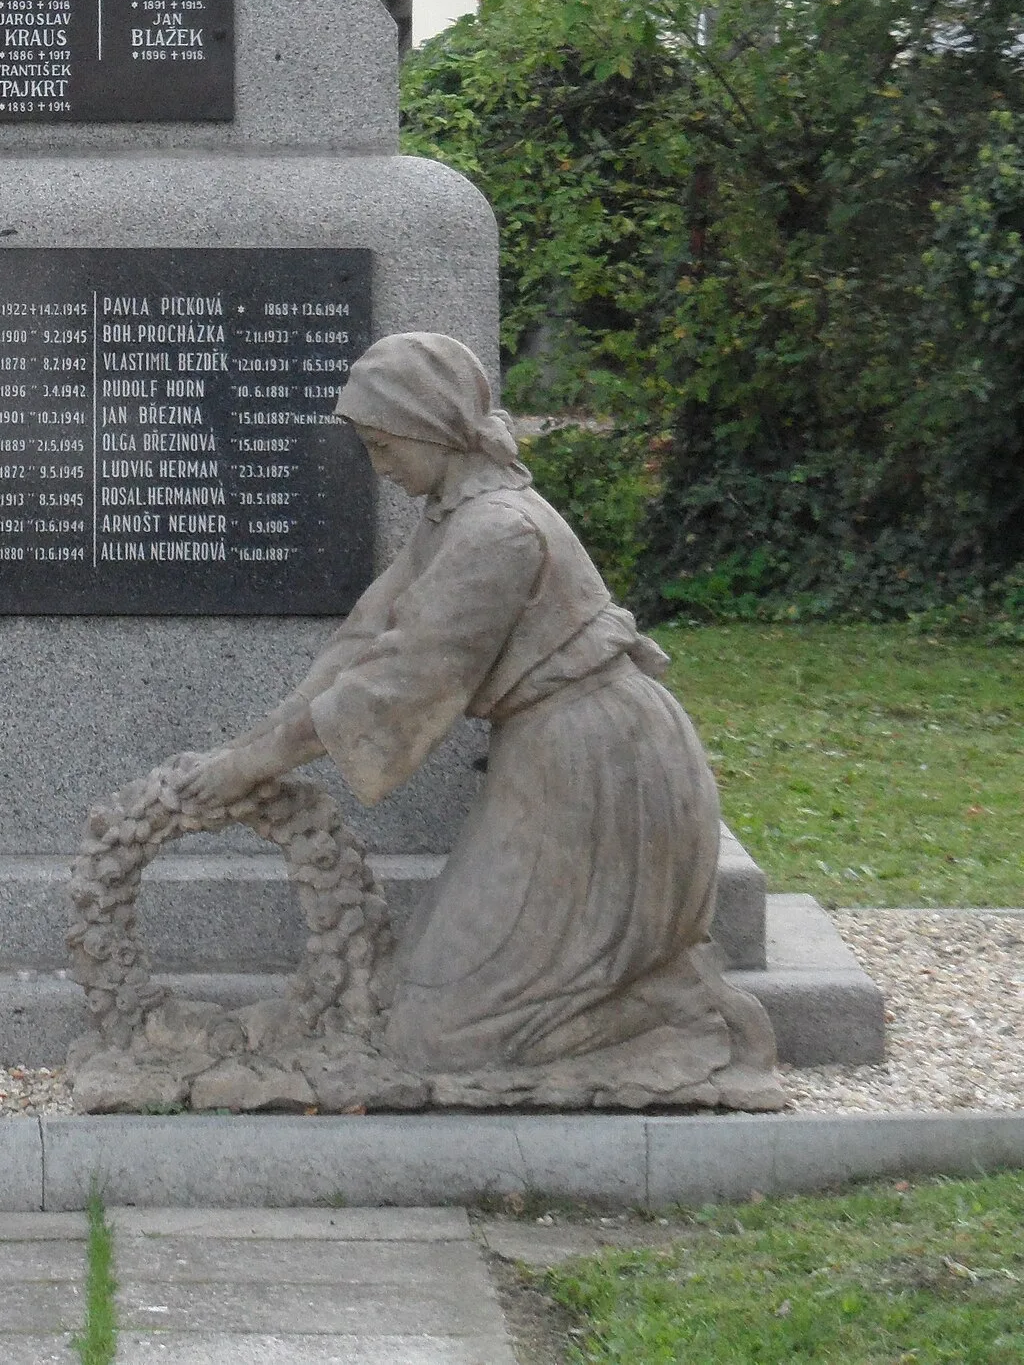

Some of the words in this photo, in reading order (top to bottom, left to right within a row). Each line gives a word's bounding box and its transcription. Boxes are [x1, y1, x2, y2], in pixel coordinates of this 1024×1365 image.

[7, 1, 33, 9] 1893
[143, 1, 165, 9] 1891
[152, 14, 182, 26] JAN
[5, 29, 67, 46] KRAUS
[131, 25, 203, 46] BLAŽEK
[8, 51, 33, 60] 1886
[49, 51, 70, 60] 1917
[141, 51, 166, 60] 1896
[0, 80, 68, 97] PAJKRT
[7, 102, 33, 111] 1883
[48, 102, 71, 111] 1914
[103, 297, 149, 315] PAVLA
[161, 292, 223, 315] PICKOVÁ
[264, 303, 288, 315] 1868
[303, 304, 349, 316] 13.6.1944
[103, 353, 172, 371] VLASTIMIL
[179, 349, 228, 371] BEZDĚK
[103, 380, 158, 397] RUDOLF
[166, 380, 205, 397] HORN
[102, 407, 127, 427] JAN
[139, 403, 202, 424] BŘEZINA
[103, 434, 136, 451] OLGA
[144, 427, 216, 451] BŘEZINOVÁ
[103, 460, 153, 478] LUDVIG
[160, 460, 218, 478] HERMAN
[103, 511, 160, 532] ARNOŠT
[169, 515, 226, 533] NEUNER
[101, 542, 144, 560] ALLINA
[151, 538, 226, 561] NEUNEROVÁ
